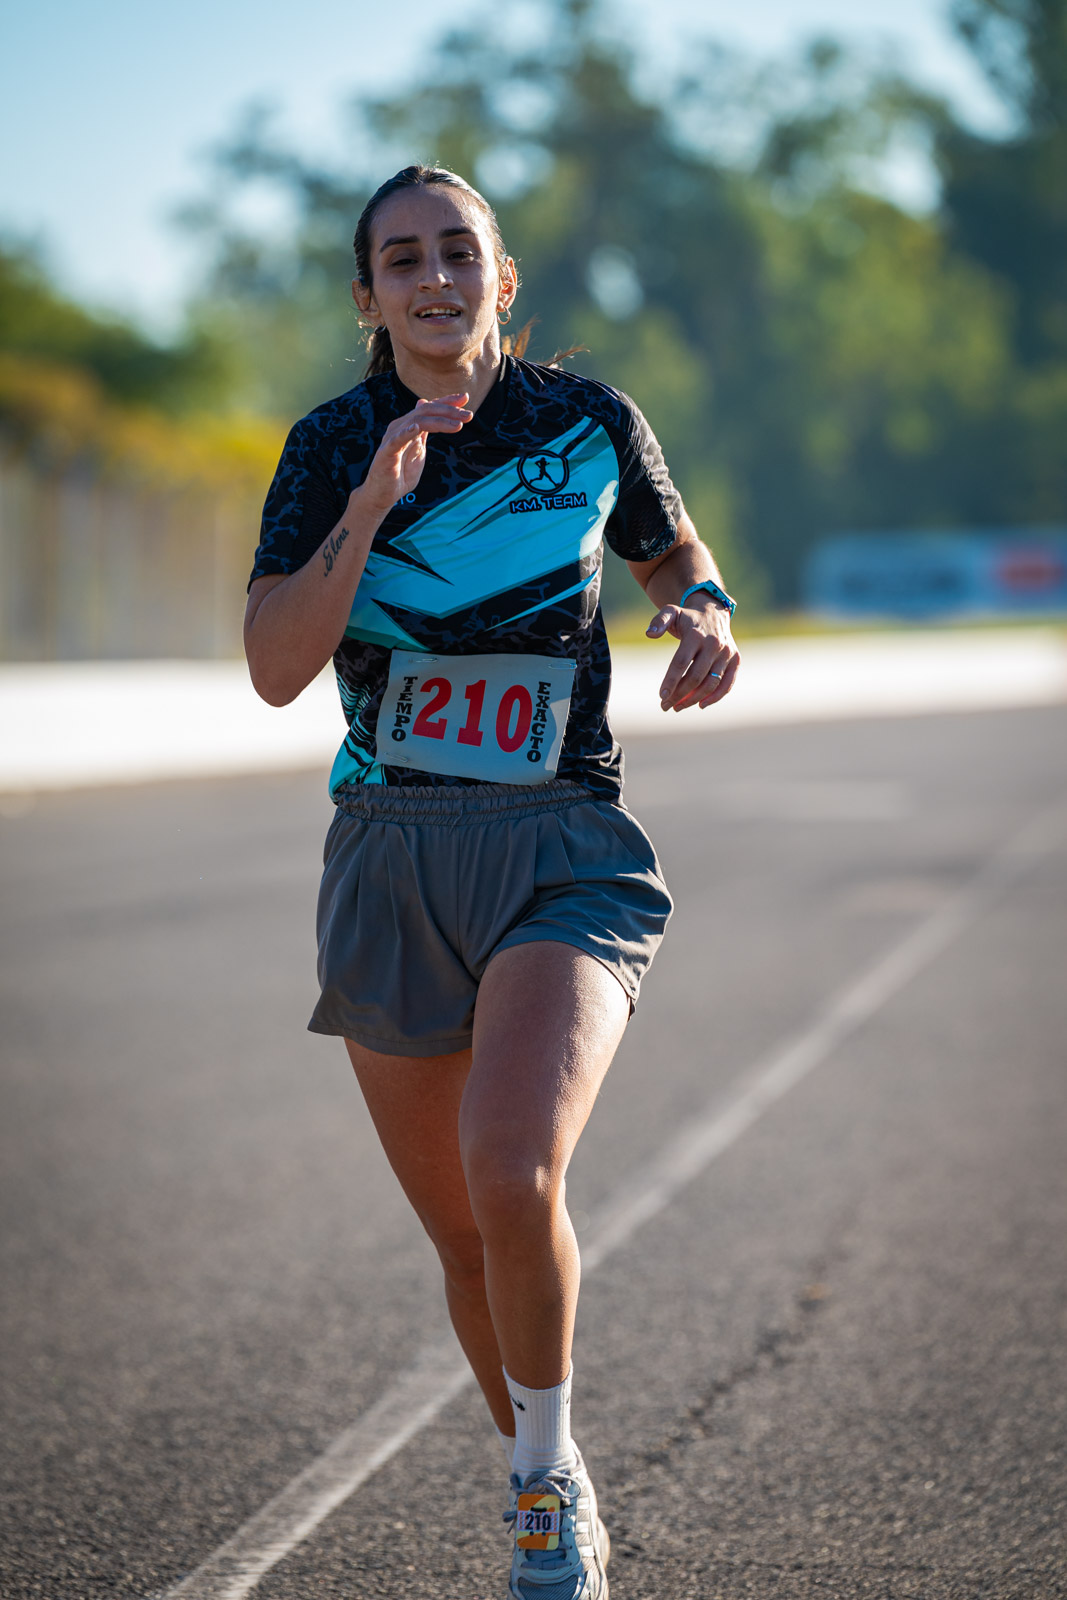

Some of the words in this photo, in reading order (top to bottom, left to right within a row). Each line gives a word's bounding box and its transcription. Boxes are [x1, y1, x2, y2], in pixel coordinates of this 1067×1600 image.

[511, 499, 542, 513] KM.
[541, 493, 587, 510] TEAM
[323, 527, 349, 577] Elena
[391, 676, 418, 742] TIEMPO
[412, 677, 533, 753] 210
[526, 681, 551, 763] EXACTO
[525, 1514, 551, 1531] 210
